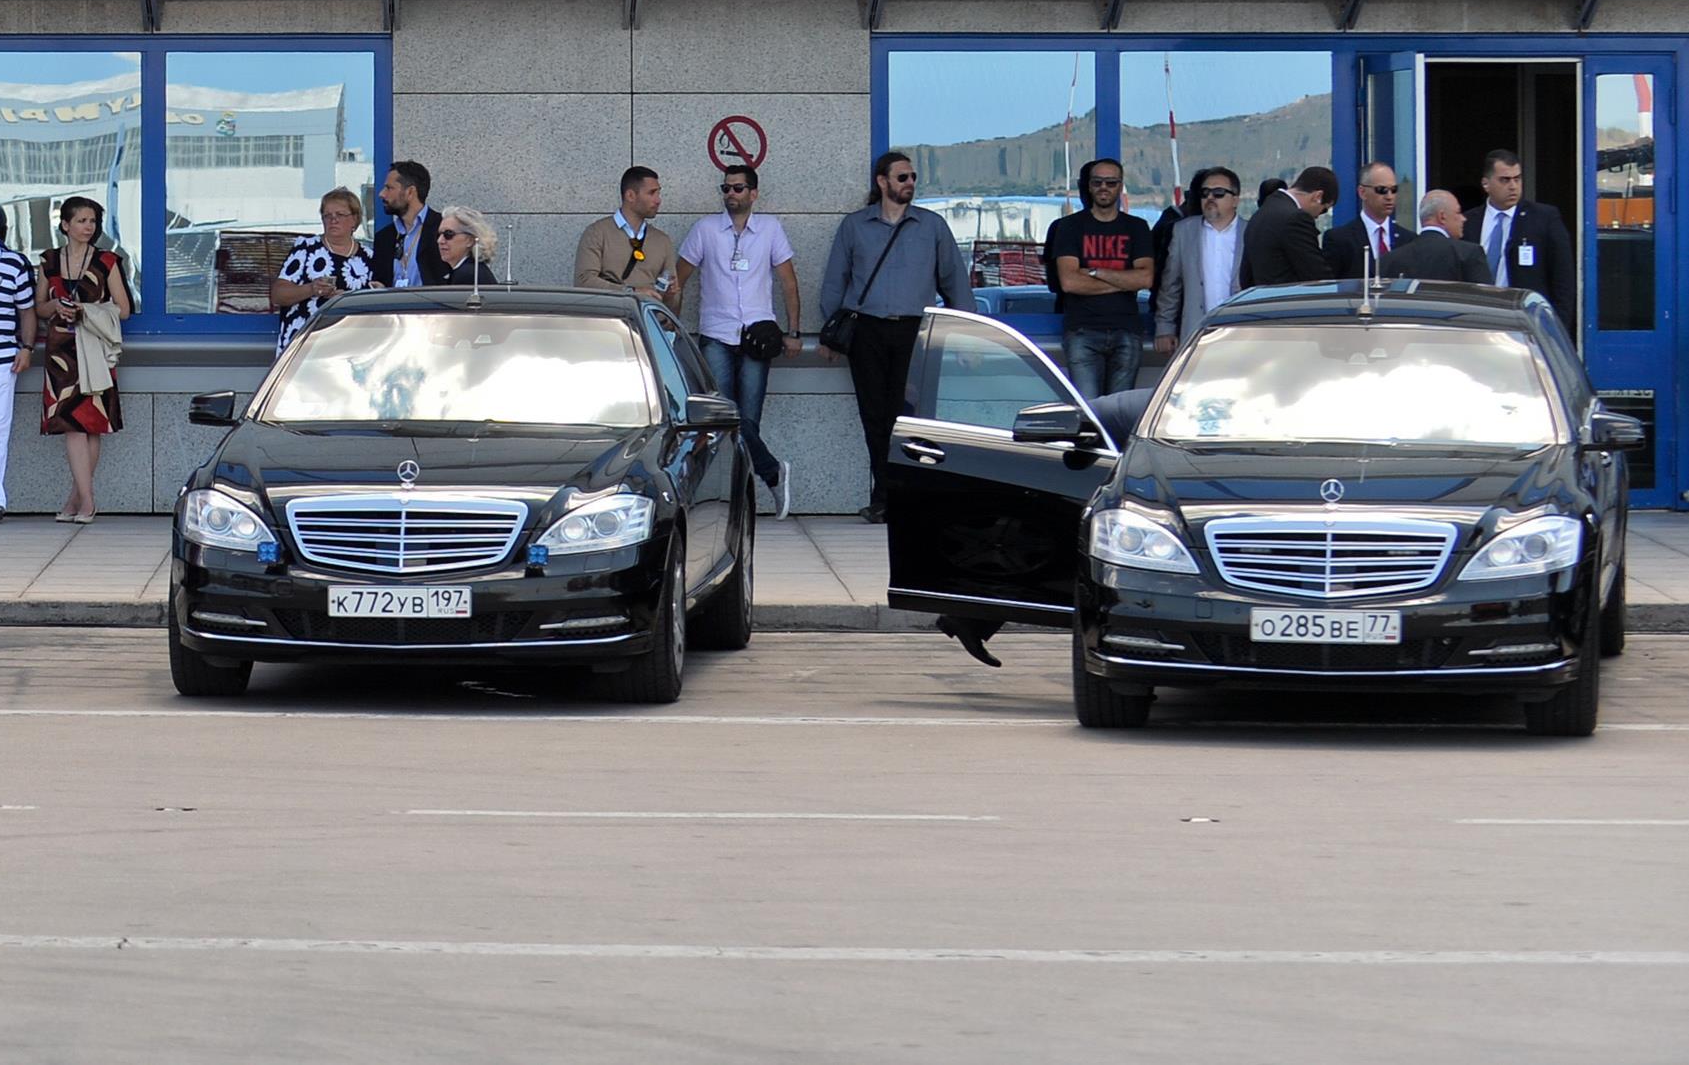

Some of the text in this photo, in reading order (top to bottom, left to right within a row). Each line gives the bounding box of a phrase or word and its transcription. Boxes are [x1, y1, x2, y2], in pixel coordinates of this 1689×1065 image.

[1083, 234, 1130, 259] NIKE
[430, 590, 464, 608] 197
[1367, 615, 1391, 633] 77
